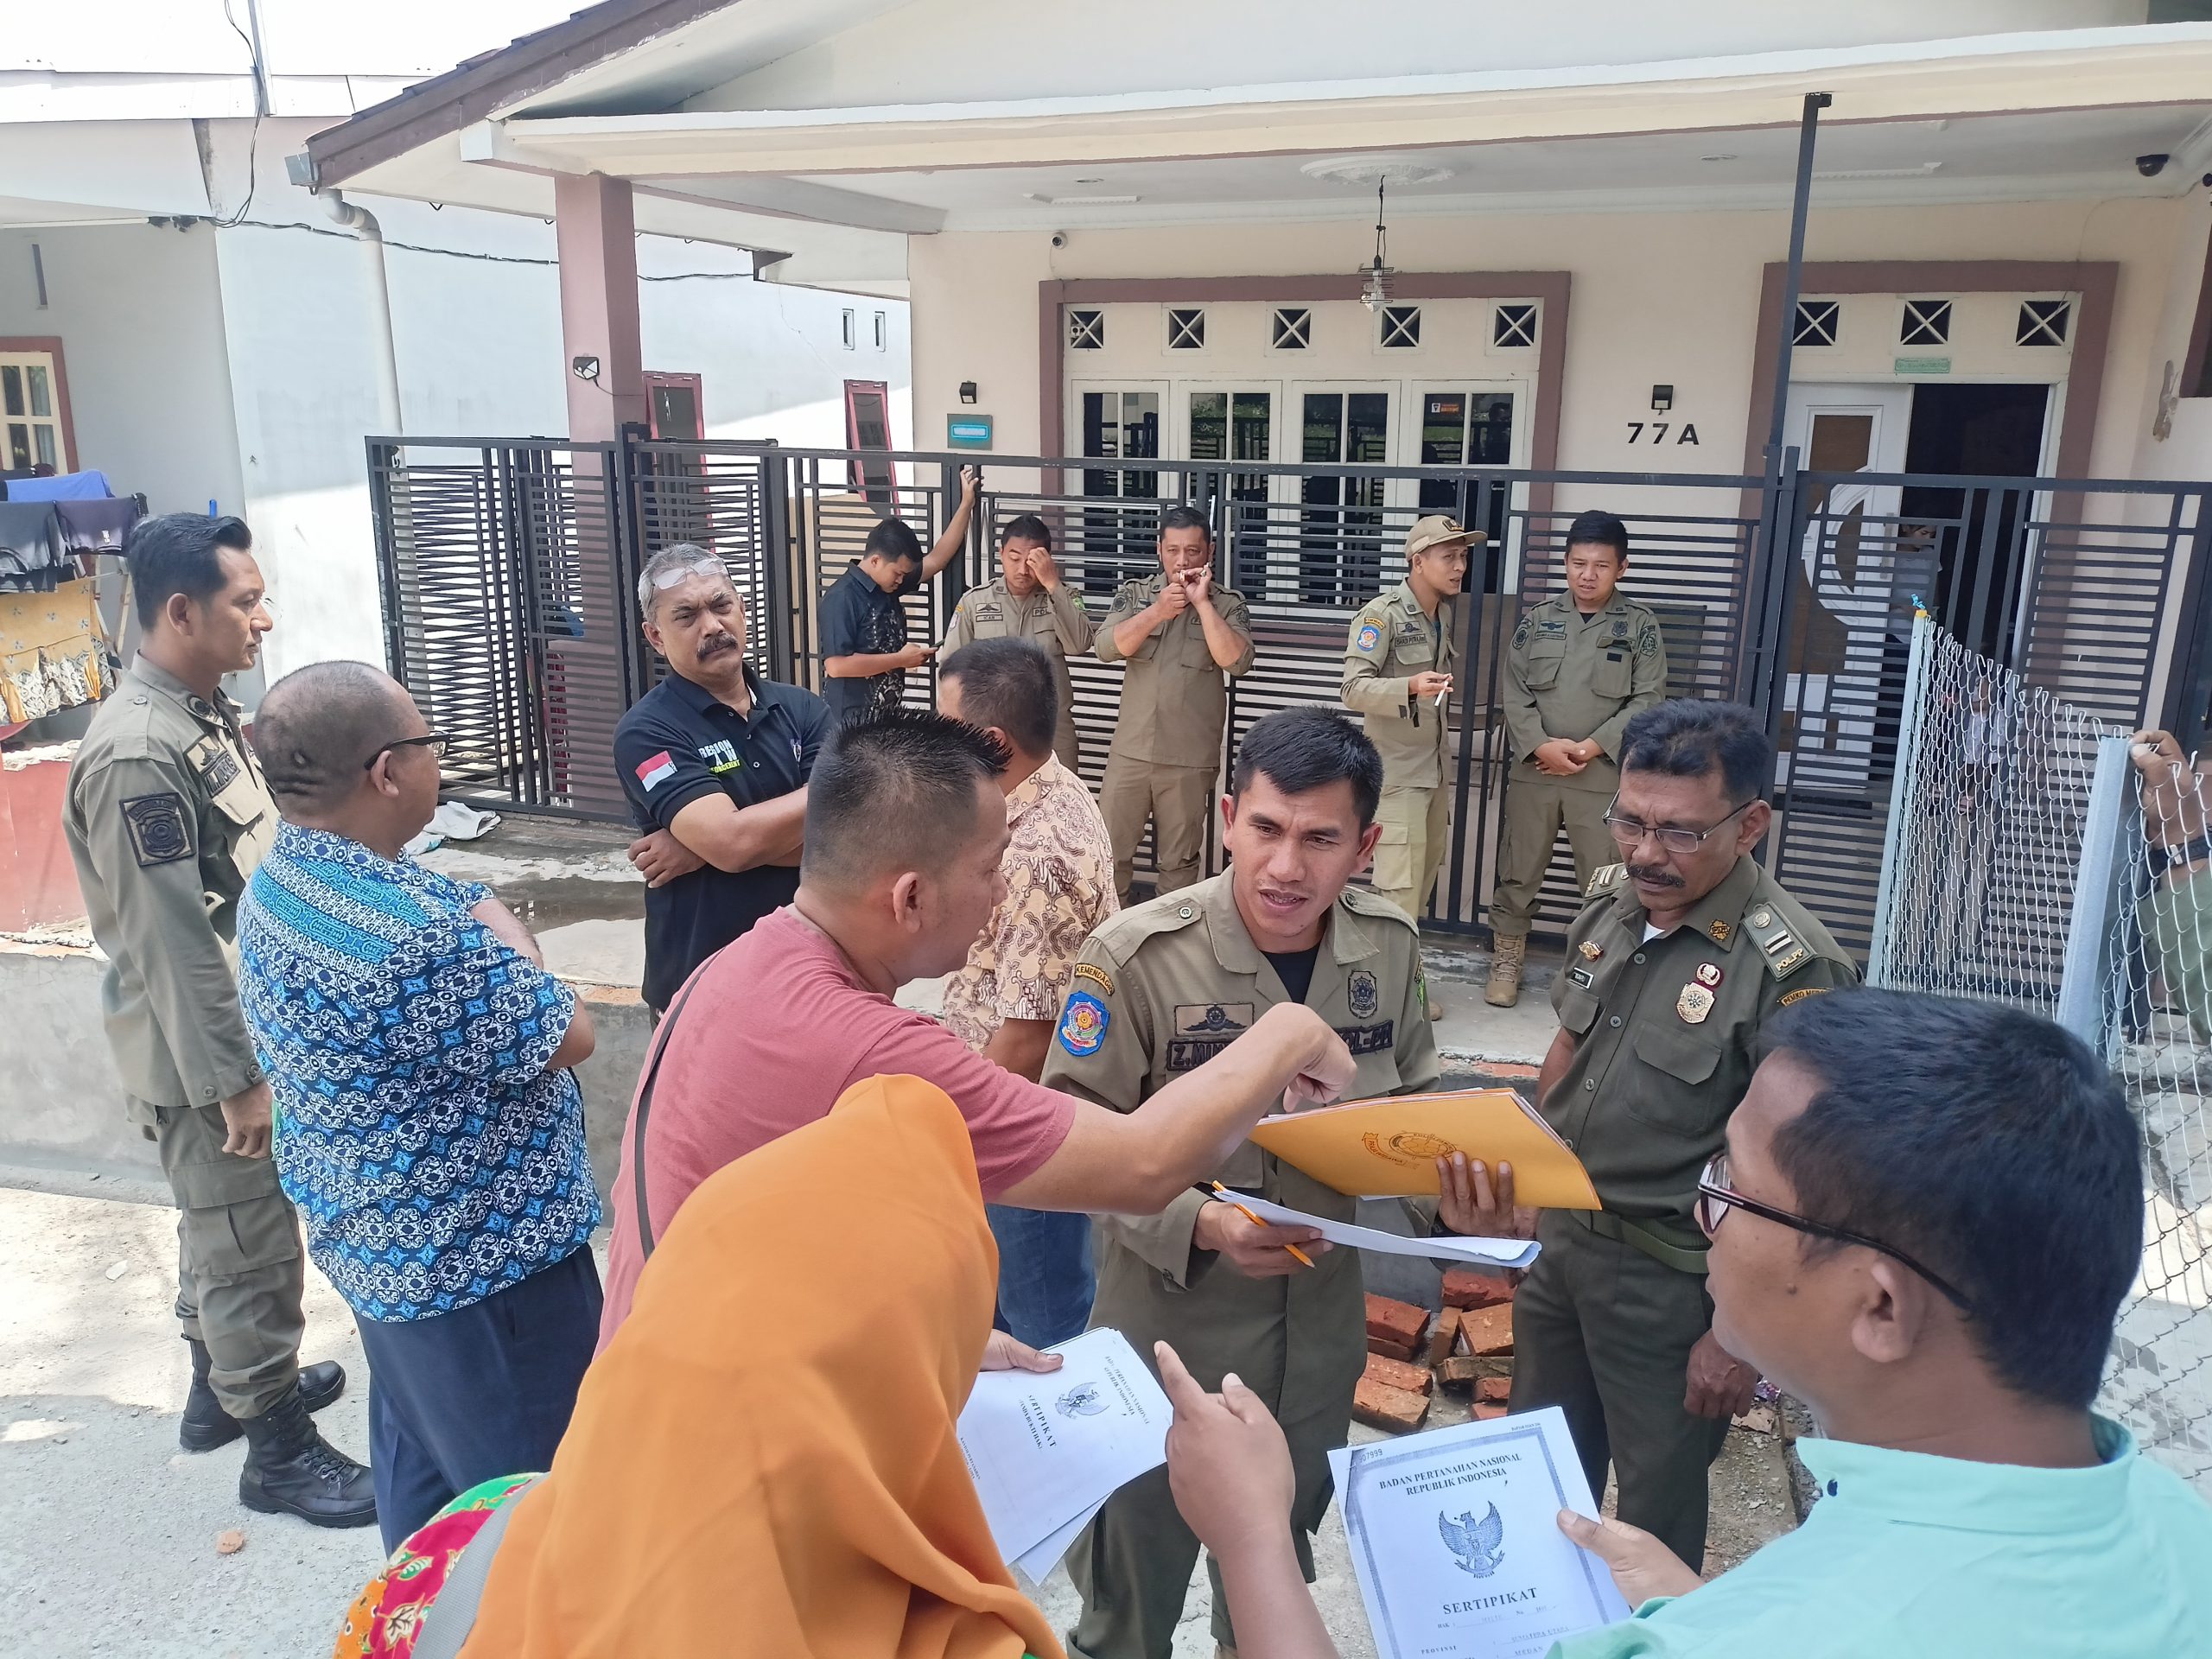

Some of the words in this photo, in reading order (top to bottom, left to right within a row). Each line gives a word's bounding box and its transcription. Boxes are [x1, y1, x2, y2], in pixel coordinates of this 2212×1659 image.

[1628, 423, 1700, 445] 77A
[698, 739, 733, 759] REGION
[1775, 948, 1803, 971] POLPP
[1340, 1023, 1392, 1052] OL-PP
[1379, 1475, 1413, 1490] BADAN
[1414, 1462, 1478, 1482] PERTANAHAN
[1479, 1452, 1522, 1469] NASIONAL
[1406, 1478, 1456, 1496] REPUBLIK
[1458, 1467, 1507, 1485] INDONESIA
[1442, 1587, 1537, 1615] SERTIPIKAT
